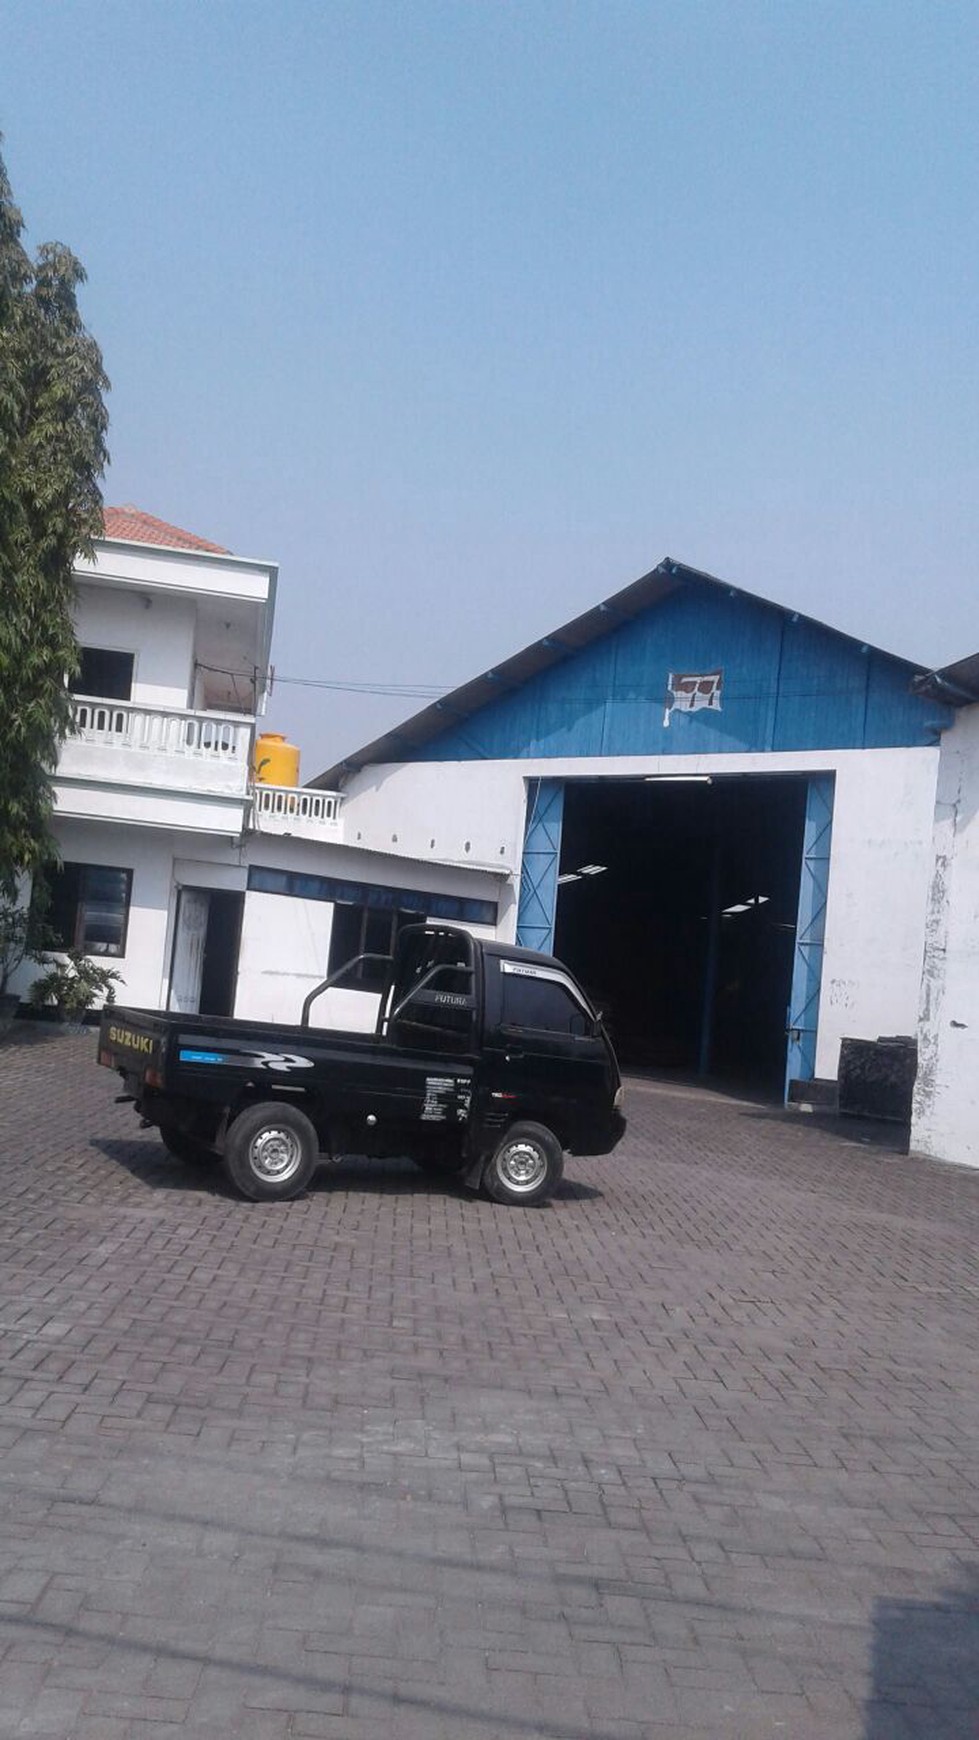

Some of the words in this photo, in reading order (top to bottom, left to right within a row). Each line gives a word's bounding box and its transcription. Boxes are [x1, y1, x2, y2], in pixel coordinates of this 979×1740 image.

[681, 676, 719, 708] 77
[434, 994, 467, 1006] FUTURA
[109, 1026, 153, 1054] SUZUKI
